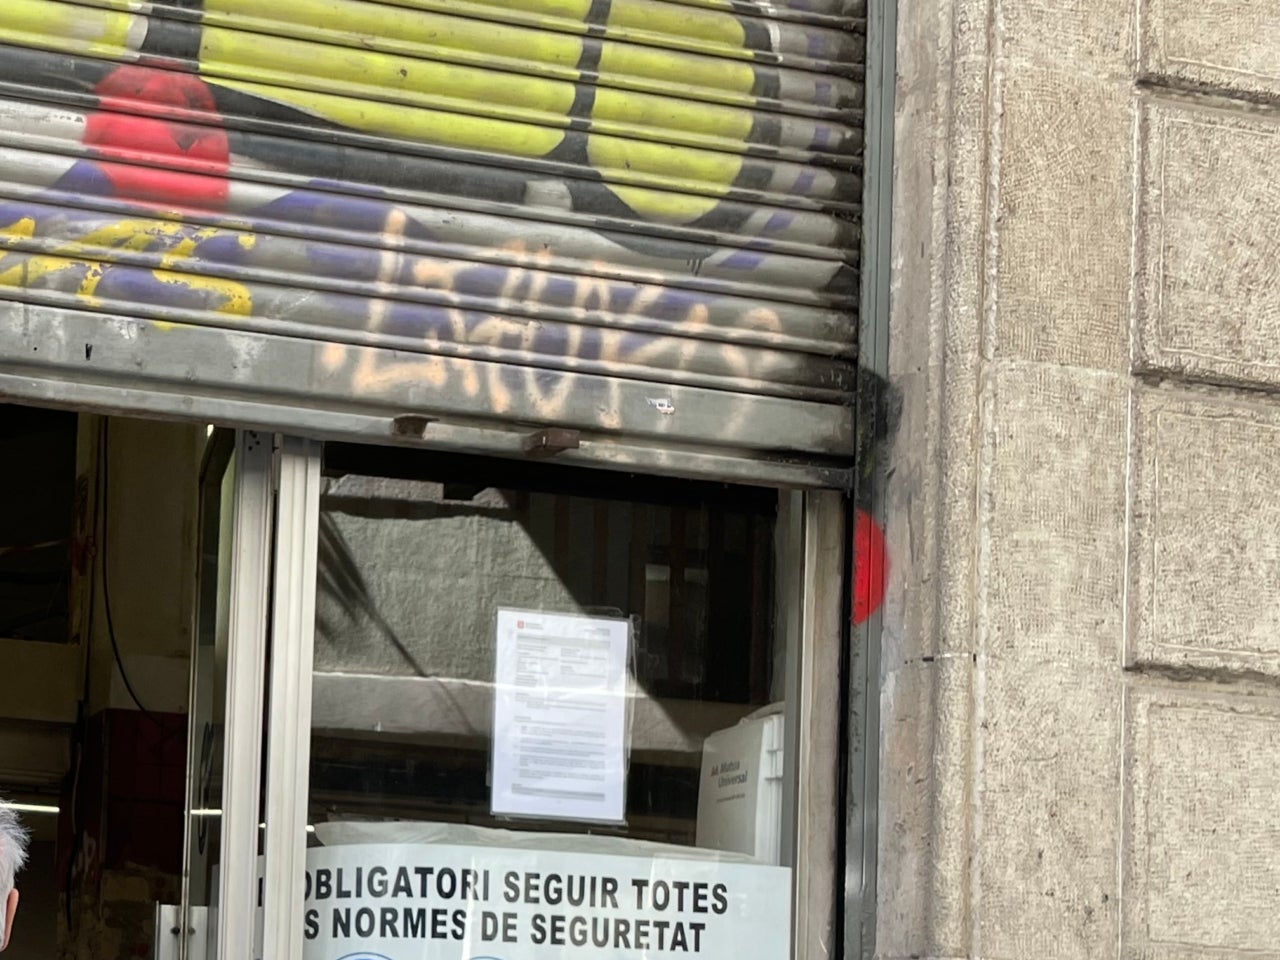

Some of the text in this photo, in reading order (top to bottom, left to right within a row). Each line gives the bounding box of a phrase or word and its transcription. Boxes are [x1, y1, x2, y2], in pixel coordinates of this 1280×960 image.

[503, 870, 618, 909] SEGUIR
[631, 878, 728, 915] TOTES
[332, 906, 466, 940] NORMES
[481, 911, 518, 943] DE
[530, 913, 706, 953] SEGURETAT
